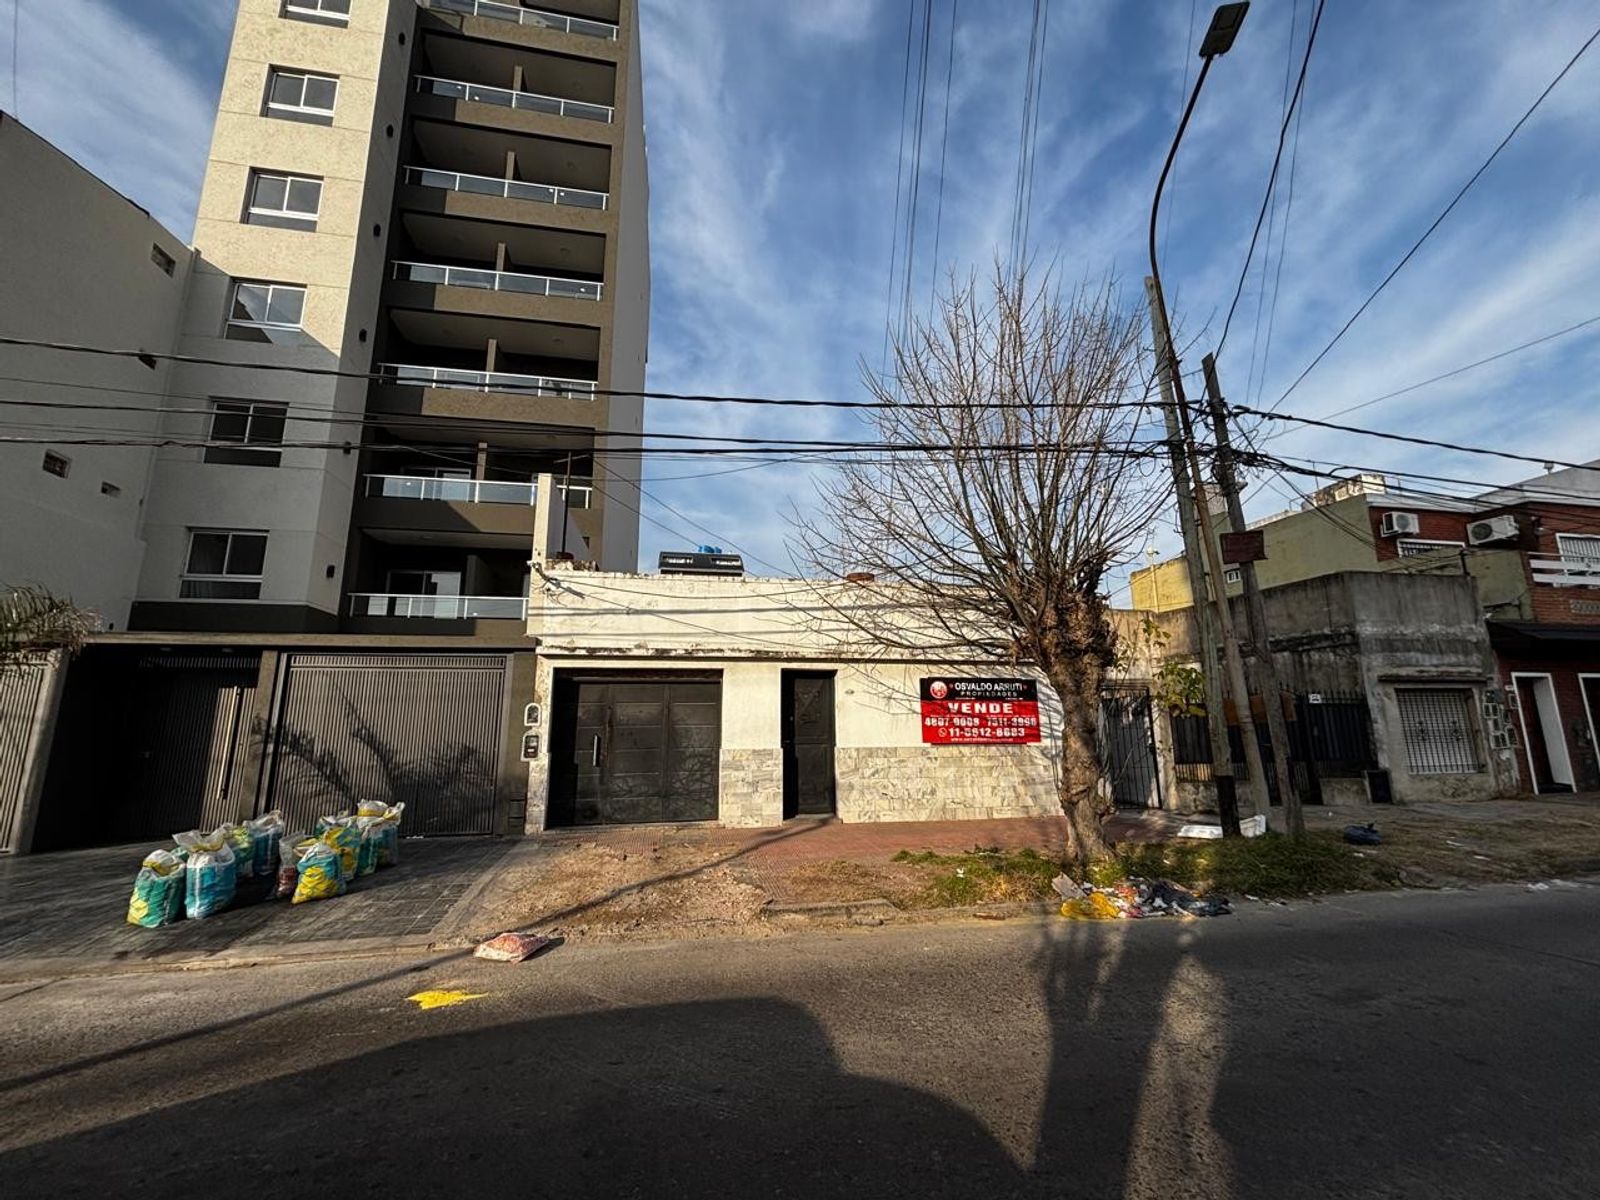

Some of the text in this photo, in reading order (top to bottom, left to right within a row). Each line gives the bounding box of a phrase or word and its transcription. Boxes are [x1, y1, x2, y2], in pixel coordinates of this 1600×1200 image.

[954, 682, 1023, 692] OSVALDO ARRUTI
[948, 702, 1014, 714] VENDE
